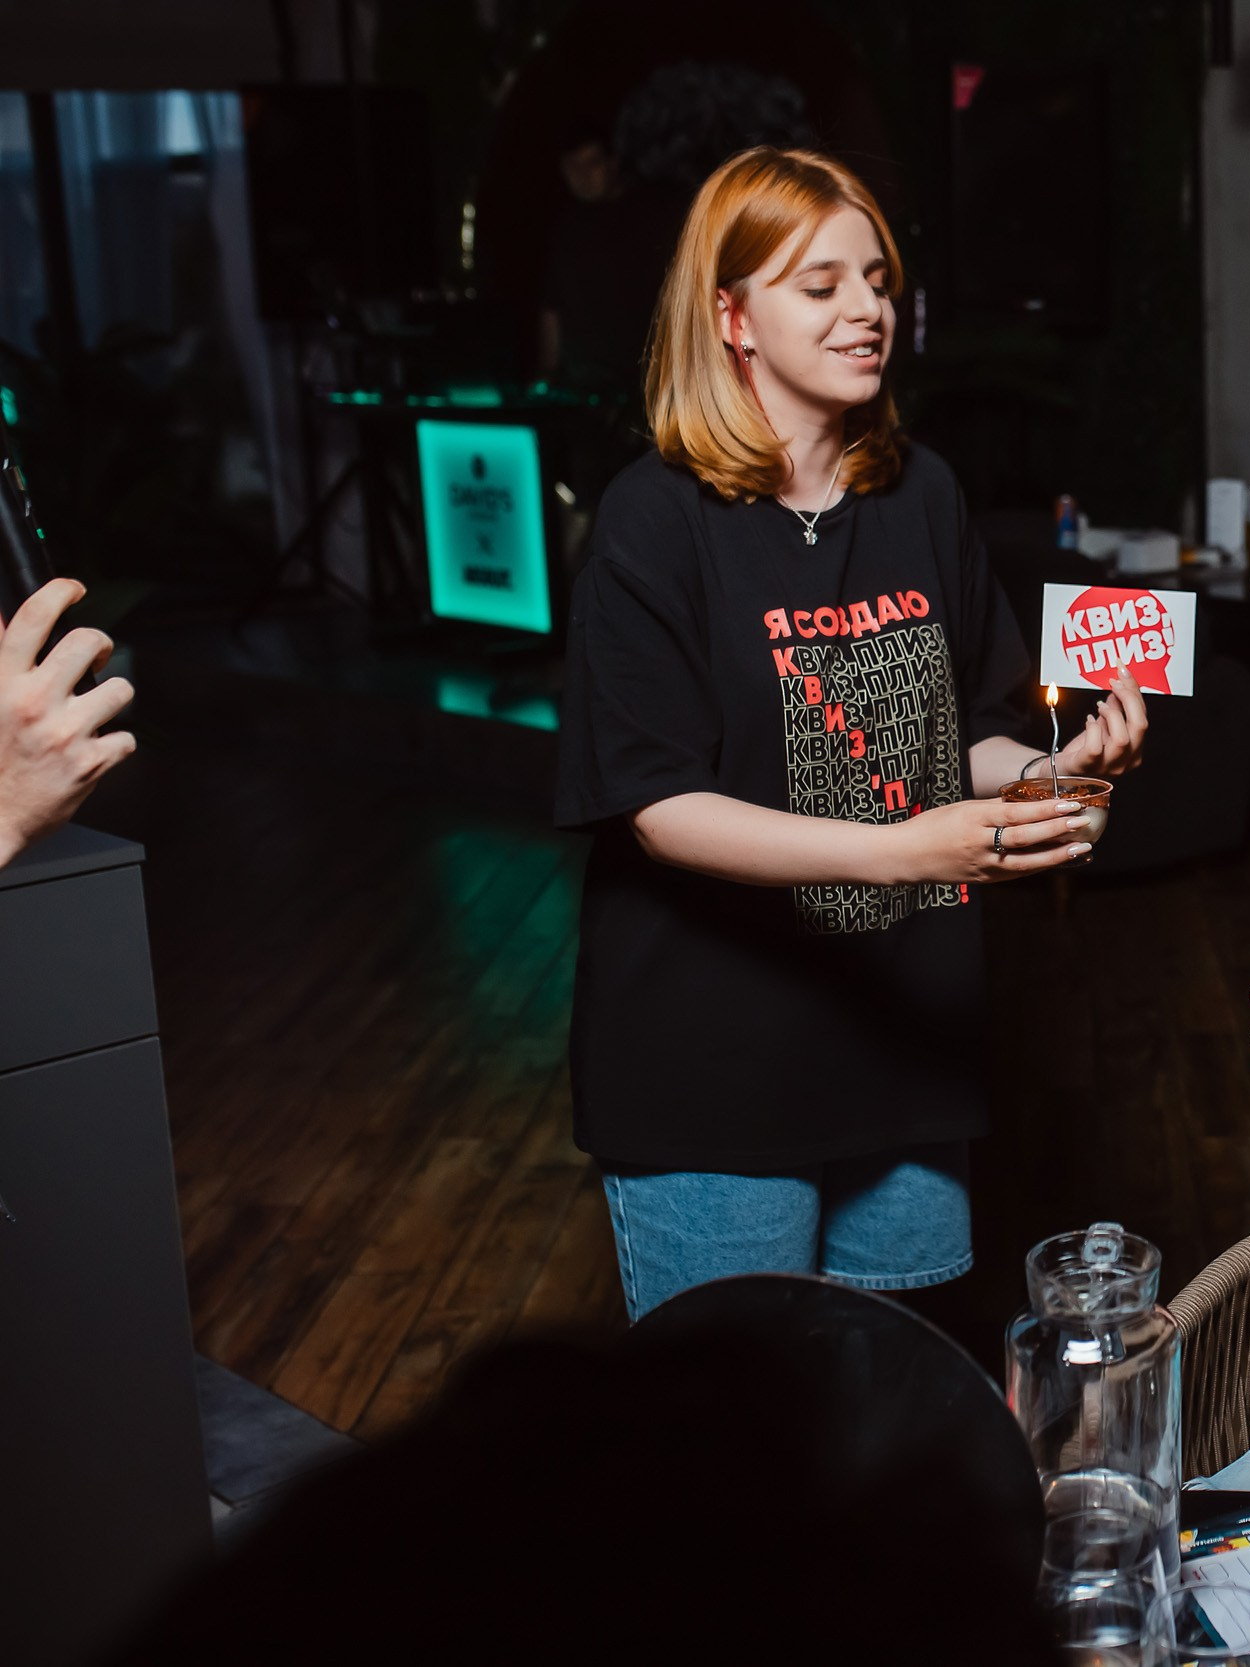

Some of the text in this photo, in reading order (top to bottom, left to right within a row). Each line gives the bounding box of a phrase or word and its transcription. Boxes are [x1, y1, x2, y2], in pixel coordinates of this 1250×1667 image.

[763, 589, 930, 640] Я СОЗДАЮ
[1063, 595, 1172, 643] КВИЗ,
[1065, 626, 1176, 674] ПЛИЗ!
